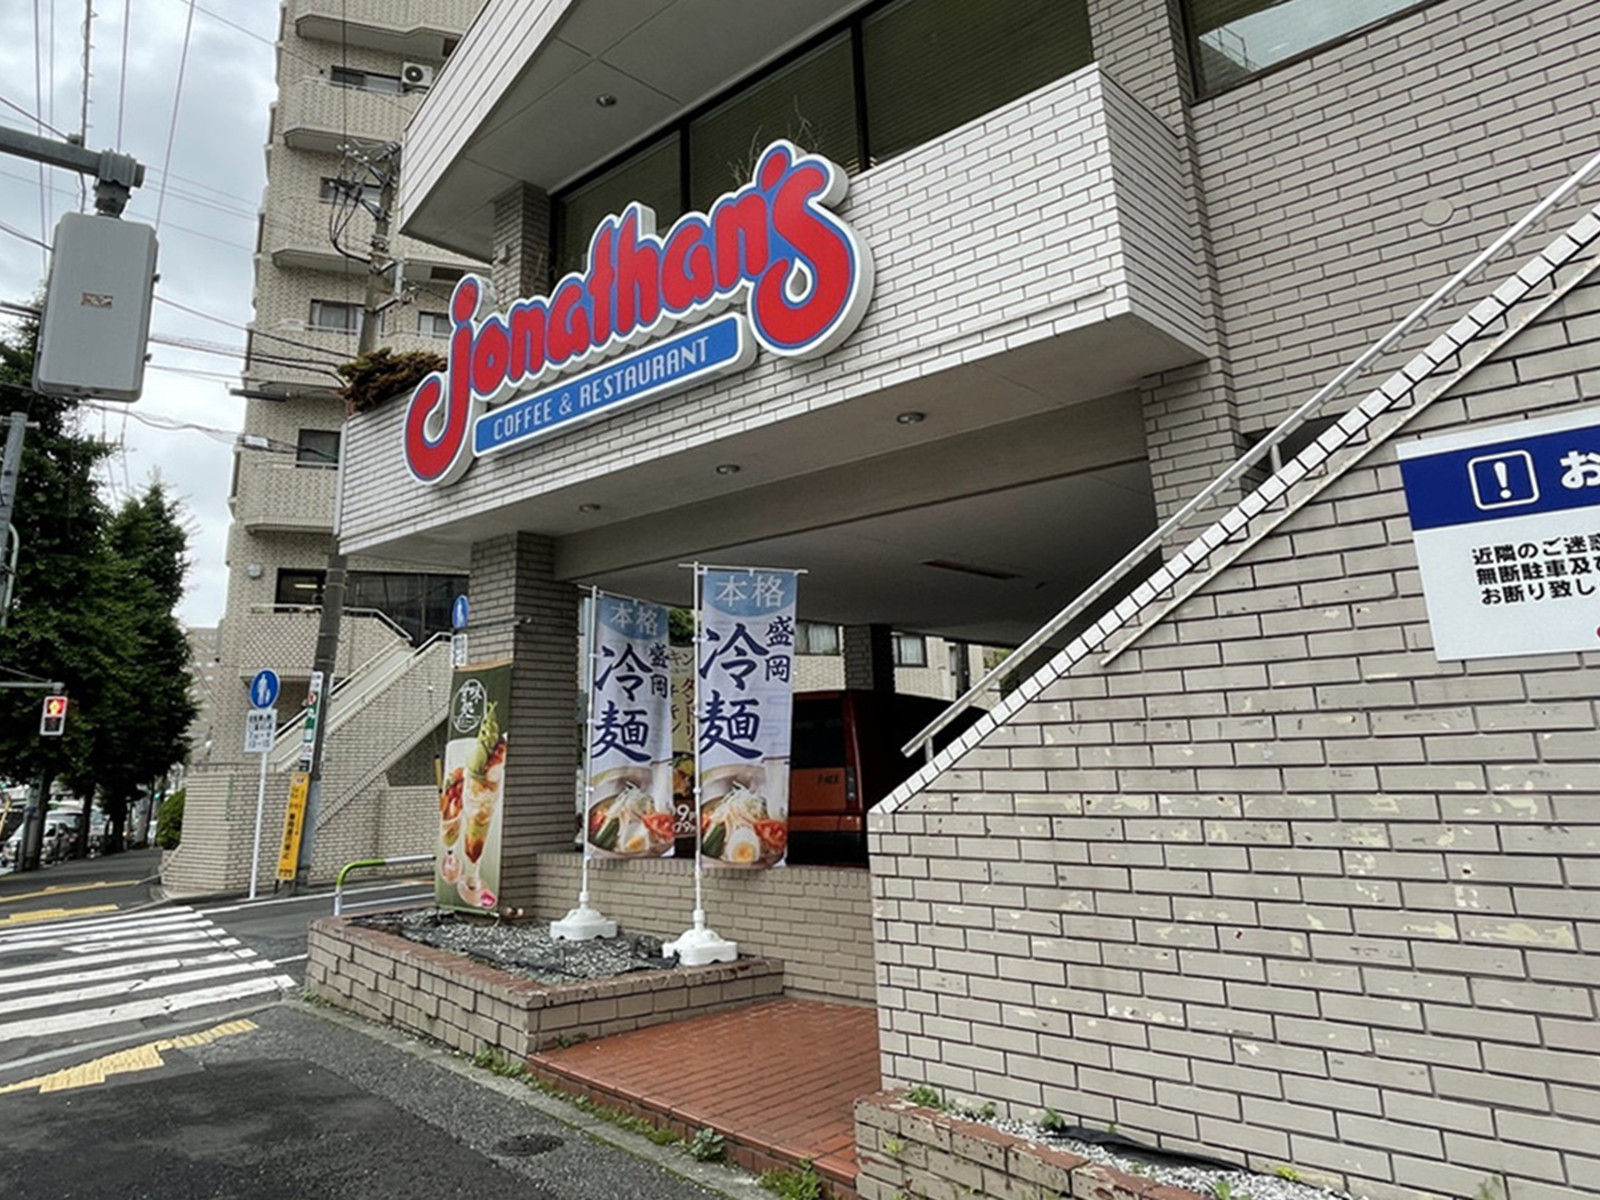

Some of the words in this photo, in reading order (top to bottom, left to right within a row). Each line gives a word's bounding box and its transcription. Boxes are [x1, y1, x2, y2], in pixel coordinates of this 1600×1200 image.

[493, 397, 552, 441] COFFEE
[558, 392, 573, 416] &
[579, 336, 710, 409] RESTAURANT
[610, 602, 658, 636] 本格
[716, 575, 785, 608] 本格
[649, 642, 670, 700] 盛岡
[765, 616, 795, 684] 盛岡
[591, 643, 653, 763] 冷麺
[699, 622, 770, 760] 冷麺
